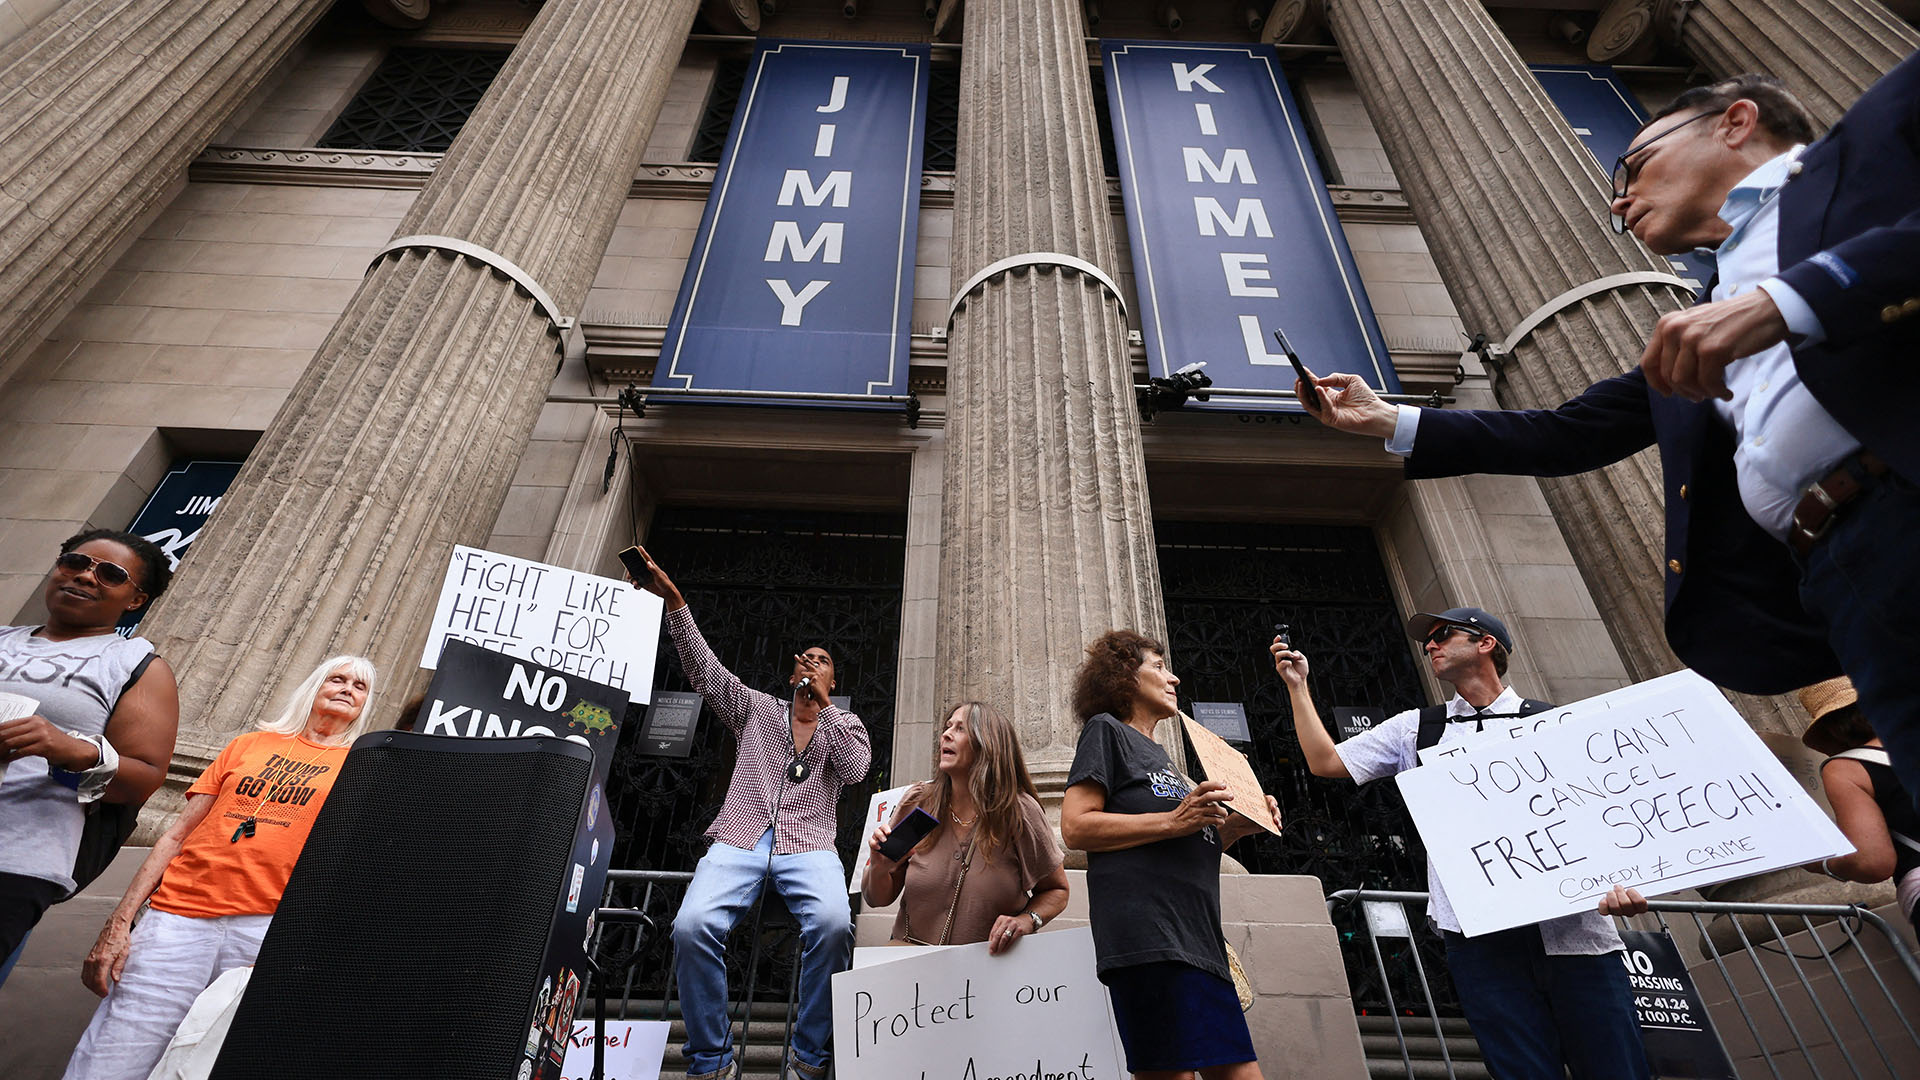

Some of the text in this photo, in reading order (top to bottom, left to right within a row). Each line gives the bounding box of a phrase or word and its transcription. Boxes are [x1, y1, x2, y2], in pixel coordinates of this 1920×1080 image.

[764, 76, 852, 327] JIMMY
[1172, 62, 1290, 366] KIMMEL
[551, 610, 609, 654] FOR
[503, 663, 567, 712] NO
[424, 699, 591, 748] KIN
[1351, 715, 1371, 727] NO
[265, 753, 330, 777] TRUMP
[1449, 751, 1554, 800] YOU
[1586, 708, 1695, 764] CAN'T
[235, 776, 317, 806] GO NOW
[258, 767, 315, 786] MUST
[1147, 772, 1187, 790] WOR
[1151, 783, 1189, 800] CHA
[1529, 763, 1676, 816] CANCEL
[1471, 772, 1782, 886] FREE SPEECH!
[1558, 864, 1642, 899] COMEDY
[1686, 836, 1756, 866] CRIME
[1621, 950, 1654, 975] NO
[1628, 975, 1683, 991] PASSING
[855, 979, 1067, 1058] Protect our
[1645, 1010, 1669, 1023] (10)
[1671, 1012, 1696, 1024] P.C.
[1654, 997, 1689, 1010] 41.24
[963, 1053, 1095, 1080] Aendment
